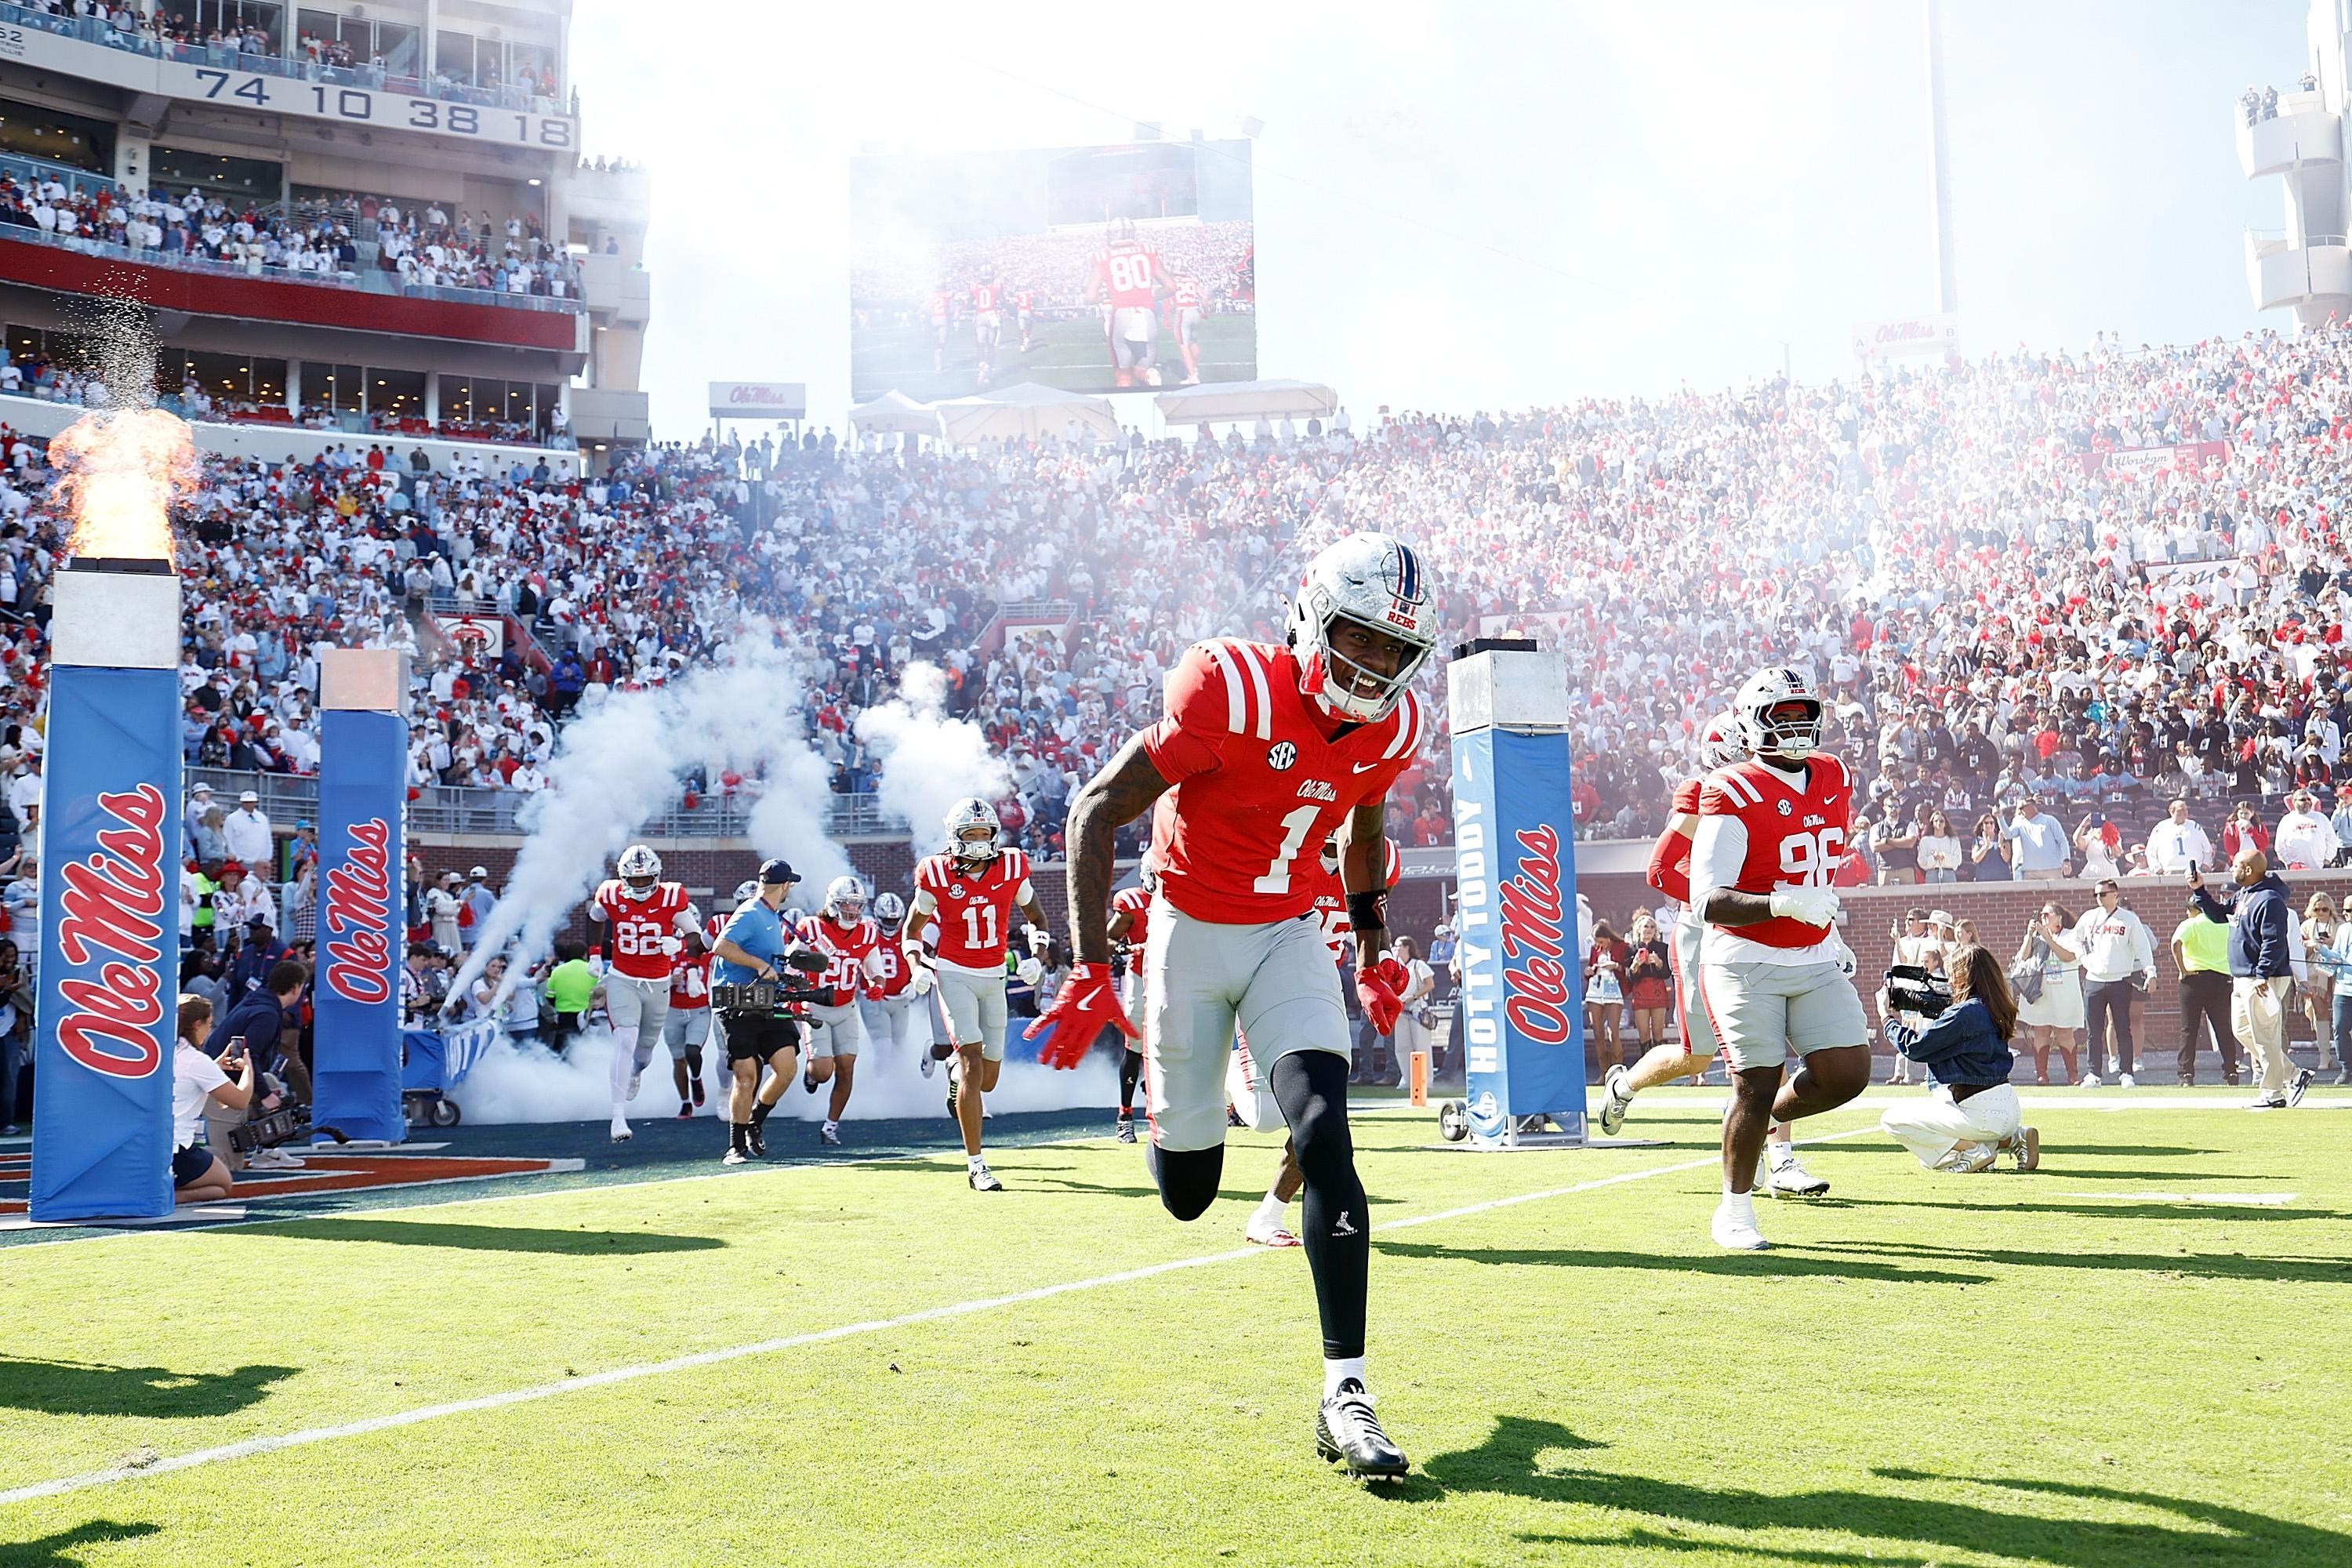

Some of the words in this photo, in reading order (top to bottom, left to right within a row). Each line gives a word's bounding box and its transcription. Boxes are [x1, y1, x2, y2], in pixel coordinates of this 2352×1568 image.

[195, 69, 270, 105] 74
[311, 86, 371, 120] 10
[408, 100, 480, 135] 38
[515, 114, 571, 147] 18
[979, 288, 991, 309] 0
[1109, 253, 1151, 292] 80
[1387, 611, 1417, 630] REBS
[1267, 741, 1297, 770] SEC
[1297, 779, 1316, 798] Ole
[1312, 781, 1337, 802] Miss
[1777, 798, 1792, 816] SEC
[1254, 804, 1321, 895] 1
[1457, 798, 1488, 931] TODDY
[1773, 827, 1844, 889] 96
[2176, 837, 2186, 855] 1
[59, 782, 166, 965] Miss
[326, 817, 389, 934] Miss
[1498, 823, 1565, 960] Miss
[616, 921, 662, 956] 82
[962, 905, 999, 949] 11
[2103, 925, 2126, 936] MISS
[326, 931, 390, 1004] Ole
[818, 956, 861, 991] 20
[57, 963, 162, 1079] Ole
[1464, 941, 1497, 1073] HOTTY
[1504, 956, 1570, 1045] Ole
